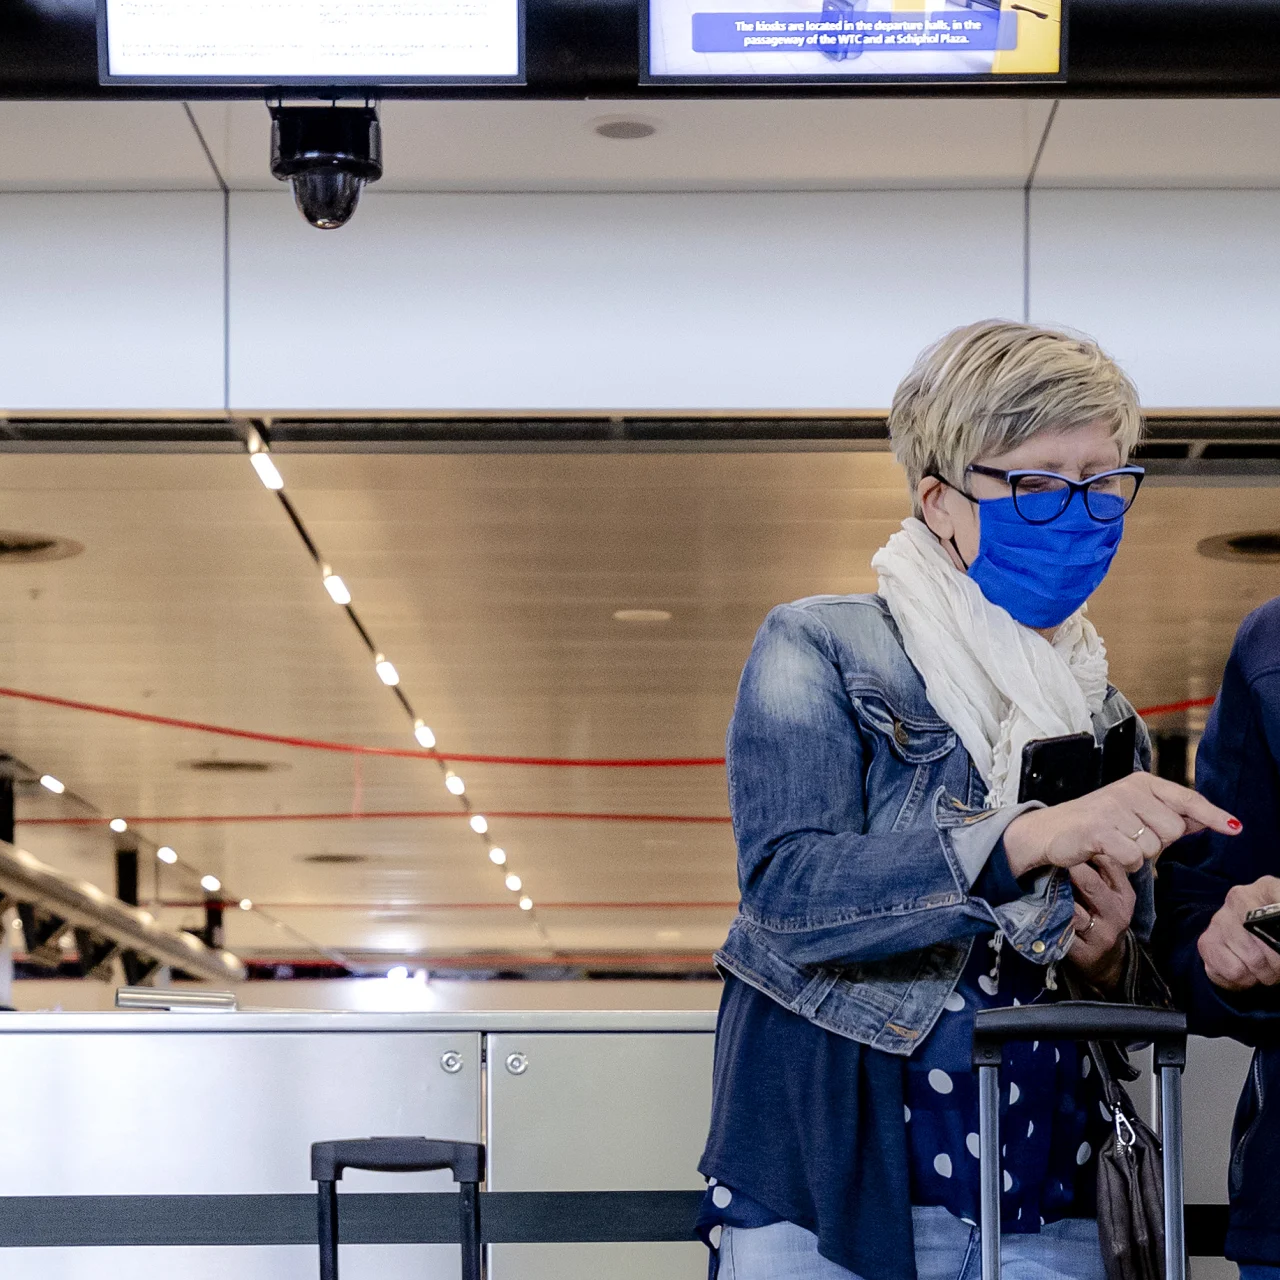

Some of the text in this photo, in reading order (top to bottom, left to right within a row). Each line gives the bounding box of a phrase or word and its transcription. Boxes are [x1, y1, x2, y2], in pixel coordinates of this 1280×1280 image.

[735, 20, 982, 32] The kiosks are located in the departure halls, in the
[743, 34, 970, 47] passageway of the WTC and at Schiphol Plaza.
